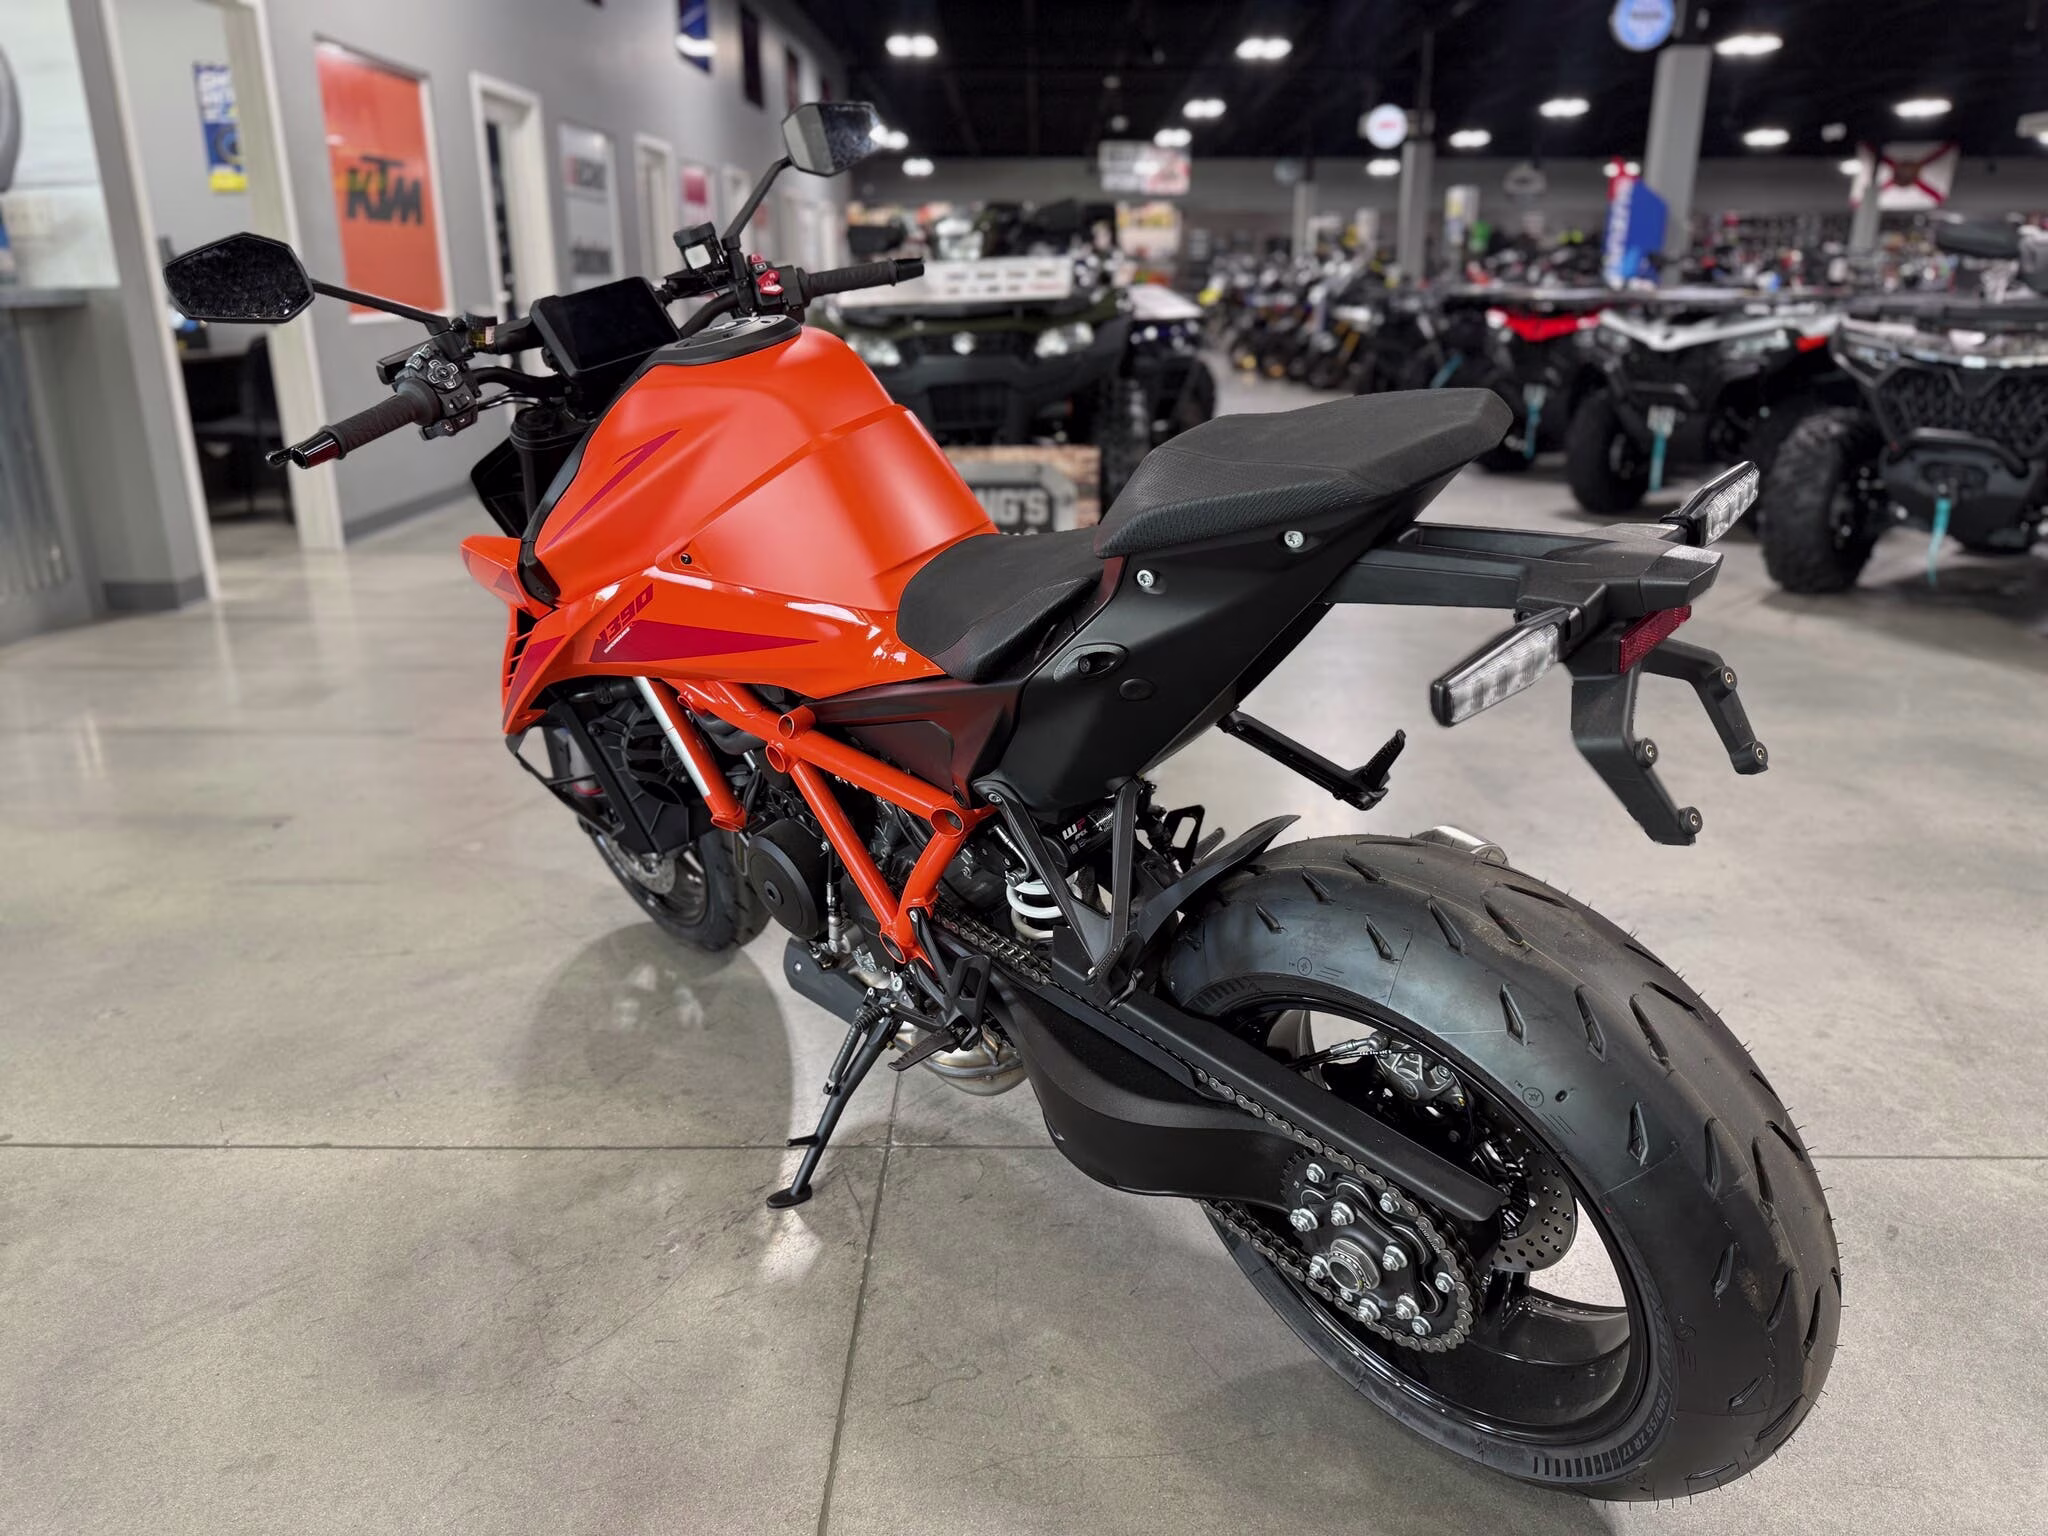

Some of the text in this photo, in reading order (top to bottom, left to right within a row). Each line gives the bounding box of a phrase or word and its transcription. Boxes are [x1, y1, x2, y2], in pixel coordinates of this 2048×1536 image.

[346, 155, 423, 225] KTM
[975, 487, 1049, 526] NG'S
[599, 582, 654, 642] 1390
